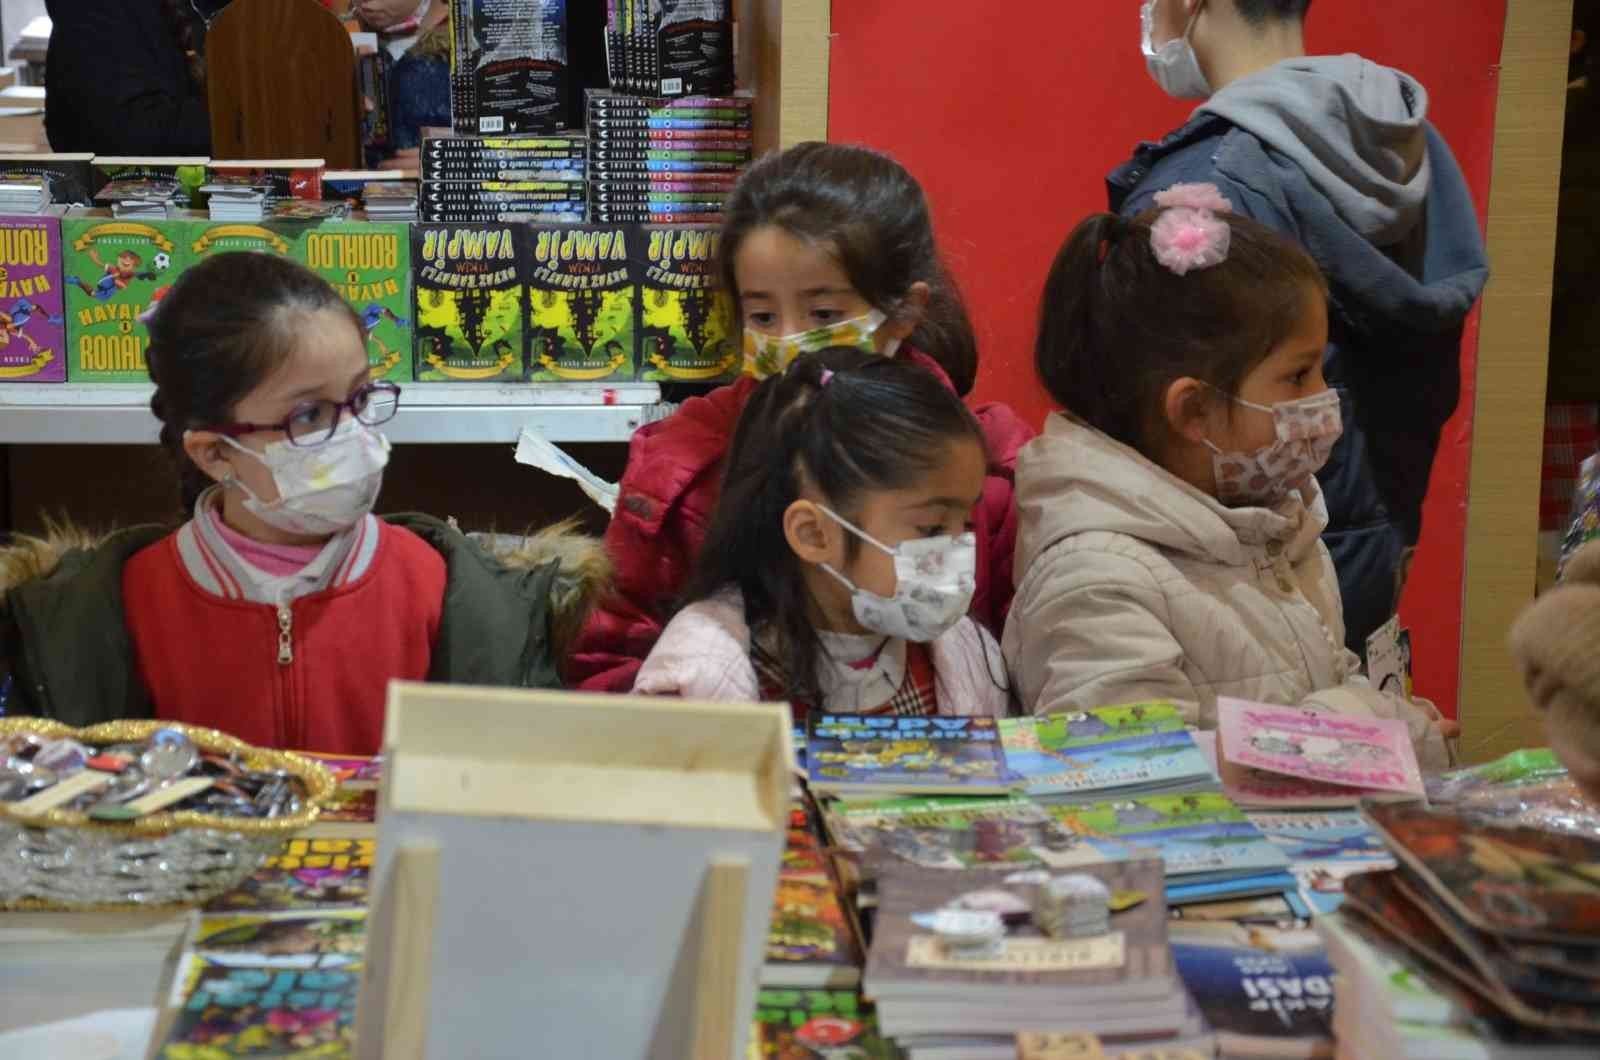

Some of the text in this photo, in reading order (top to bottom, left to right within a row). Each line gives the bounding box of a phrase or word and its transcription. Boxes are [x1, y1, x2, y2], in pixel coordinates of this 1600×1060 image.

[307, 233, 398, 270] RONALDO
[422, 229, 515, 270] VAMPİR
[535, 229, 627, 271] VAMPİR
[80, 334, 150, 370] RONAL
